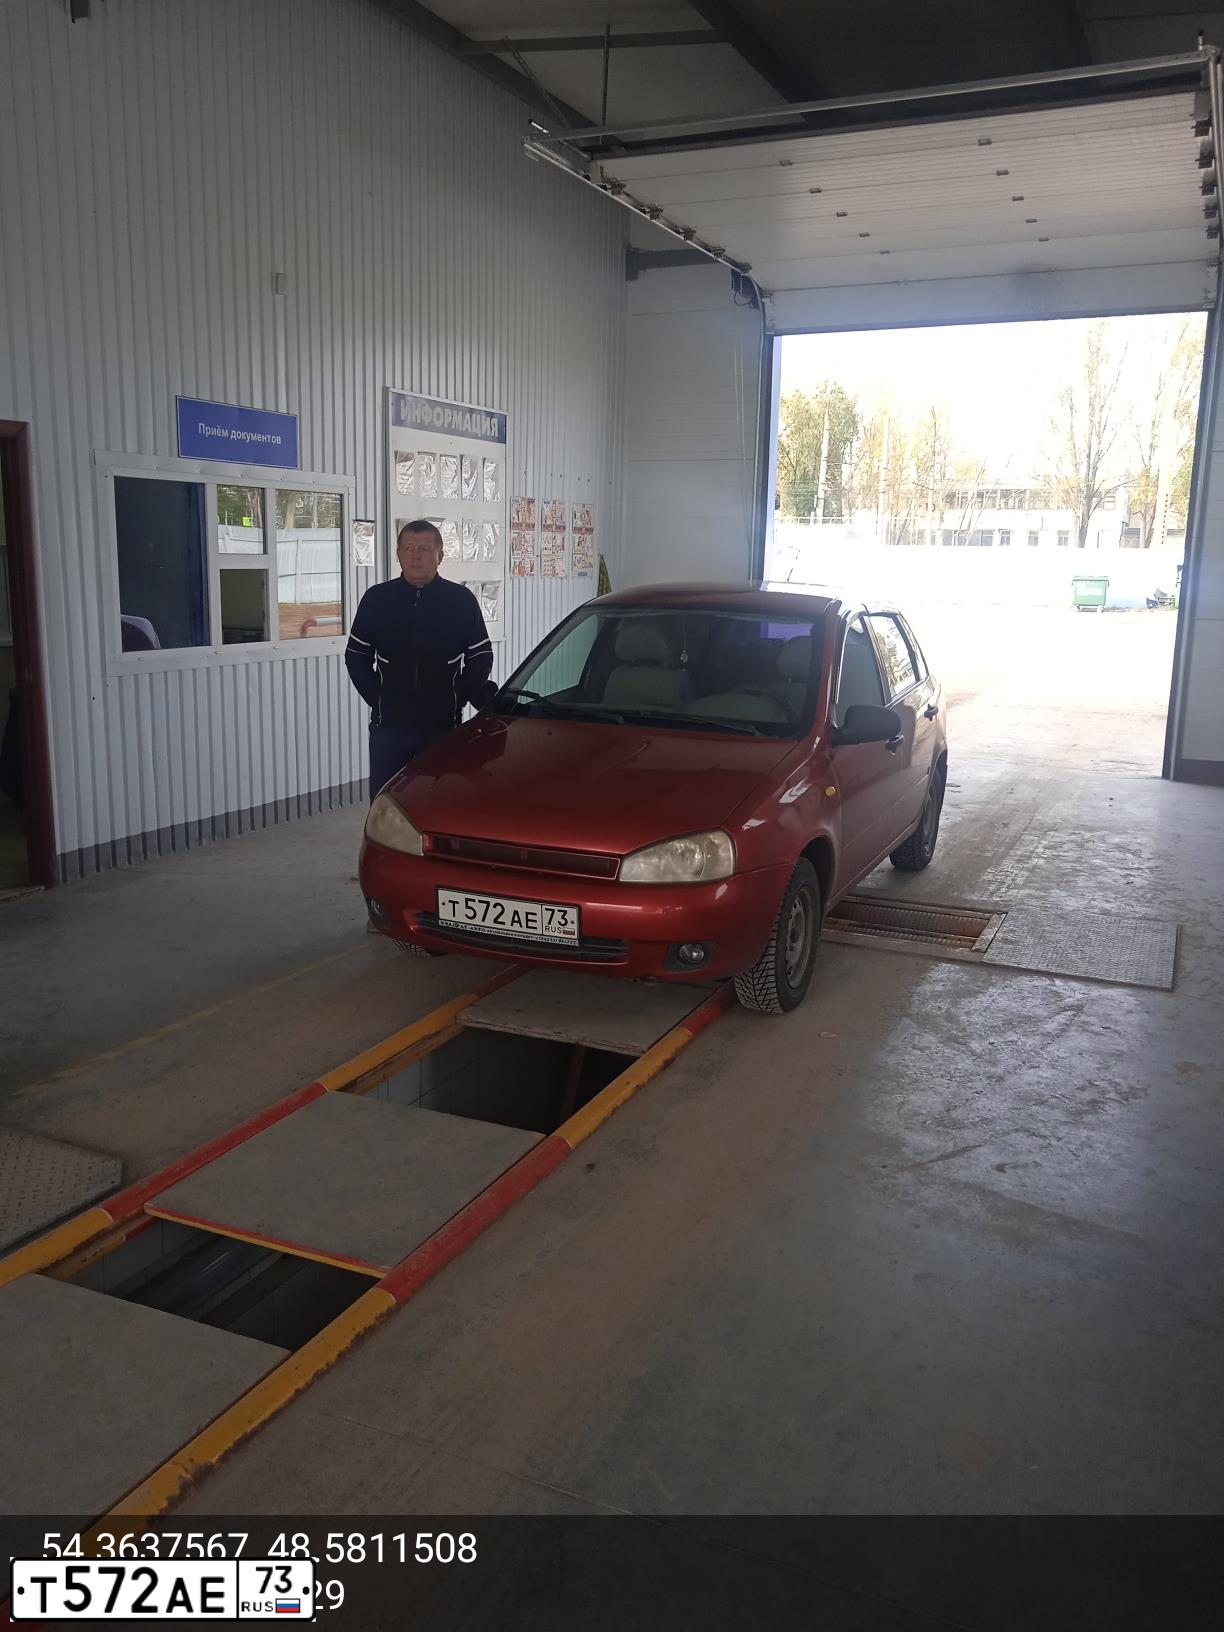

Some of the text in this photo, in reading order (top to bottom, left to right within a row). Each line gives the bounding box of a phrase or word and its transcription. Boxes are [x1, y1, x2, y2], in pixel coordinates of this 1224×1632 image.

[400, 399, 499, 437] ИНФОРМАЦИЯ
[198, 422, 282, 444] Приём документов
[544, 907, 569, 927] 73
[544, 925, 563, 934] RUS
